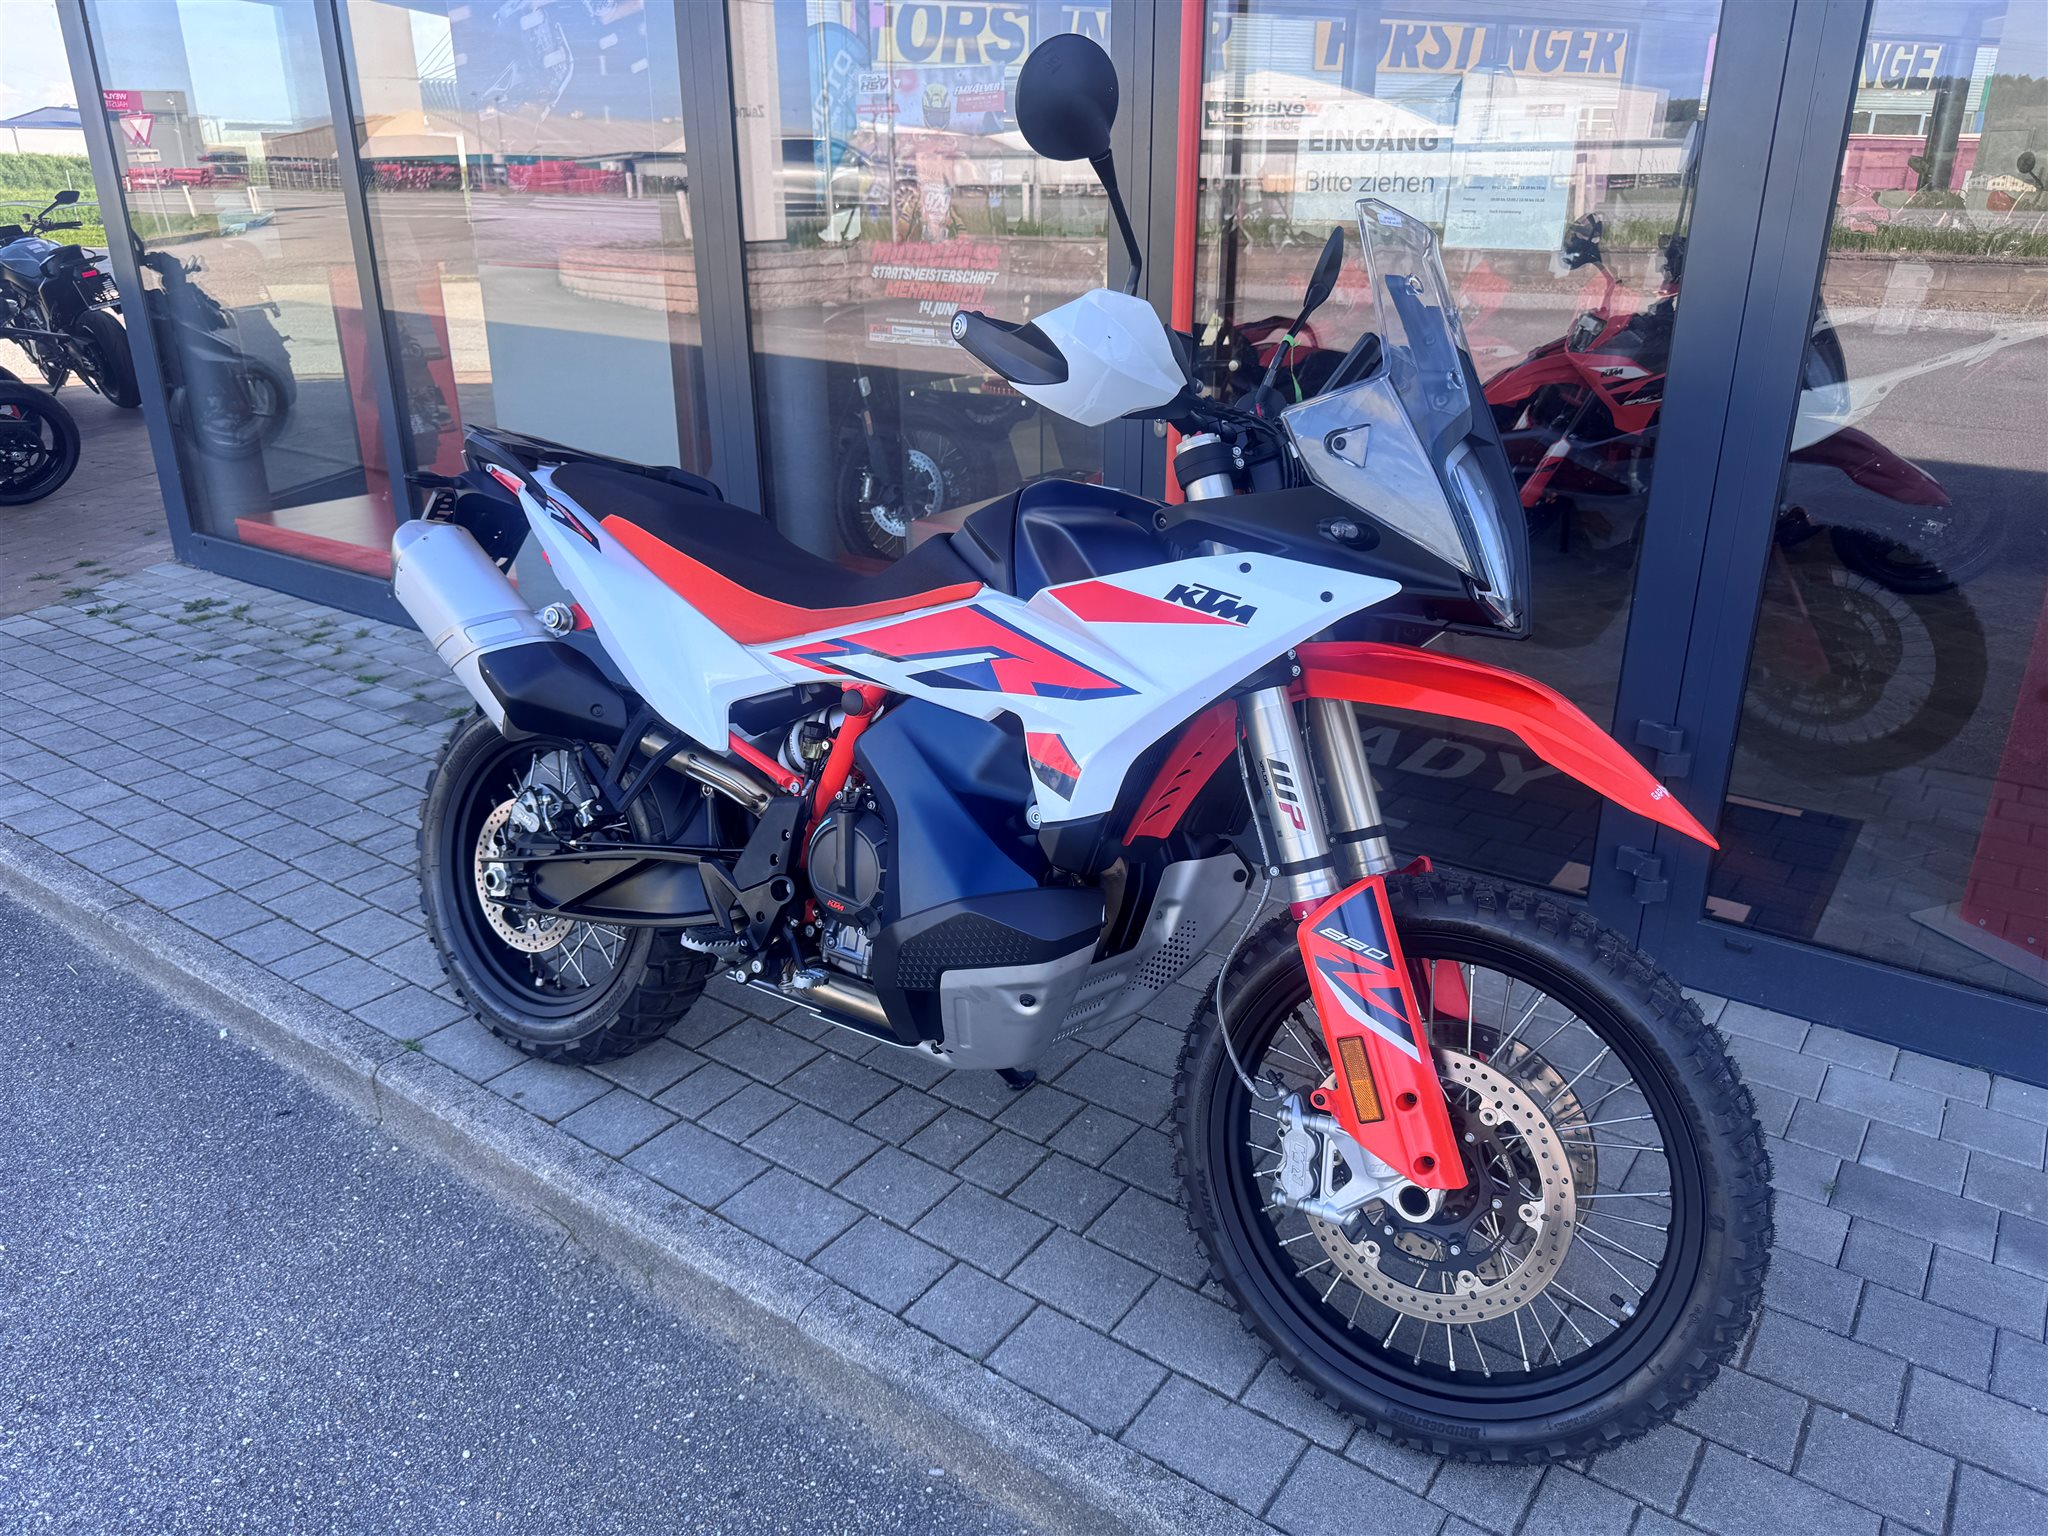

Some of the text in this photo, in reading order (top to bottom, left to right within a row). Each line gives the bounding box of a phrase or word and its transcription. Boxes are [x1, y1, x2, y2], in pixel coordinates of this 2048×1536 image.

[1308, 129, 1439, 151] EINGANG
[1305, 170, 1435, 193] Bitte ziehen
[1600, 367, 1624, 377] KTM
[1163, 583, 1258, 625] KTM
[1265, 757, 1307, 832] WP
[827, 899, 846, 912] KTM
[1319, 927, 1389, 960] 890
[1390, 1408, 1481, 1440] BRIDGESTONE
